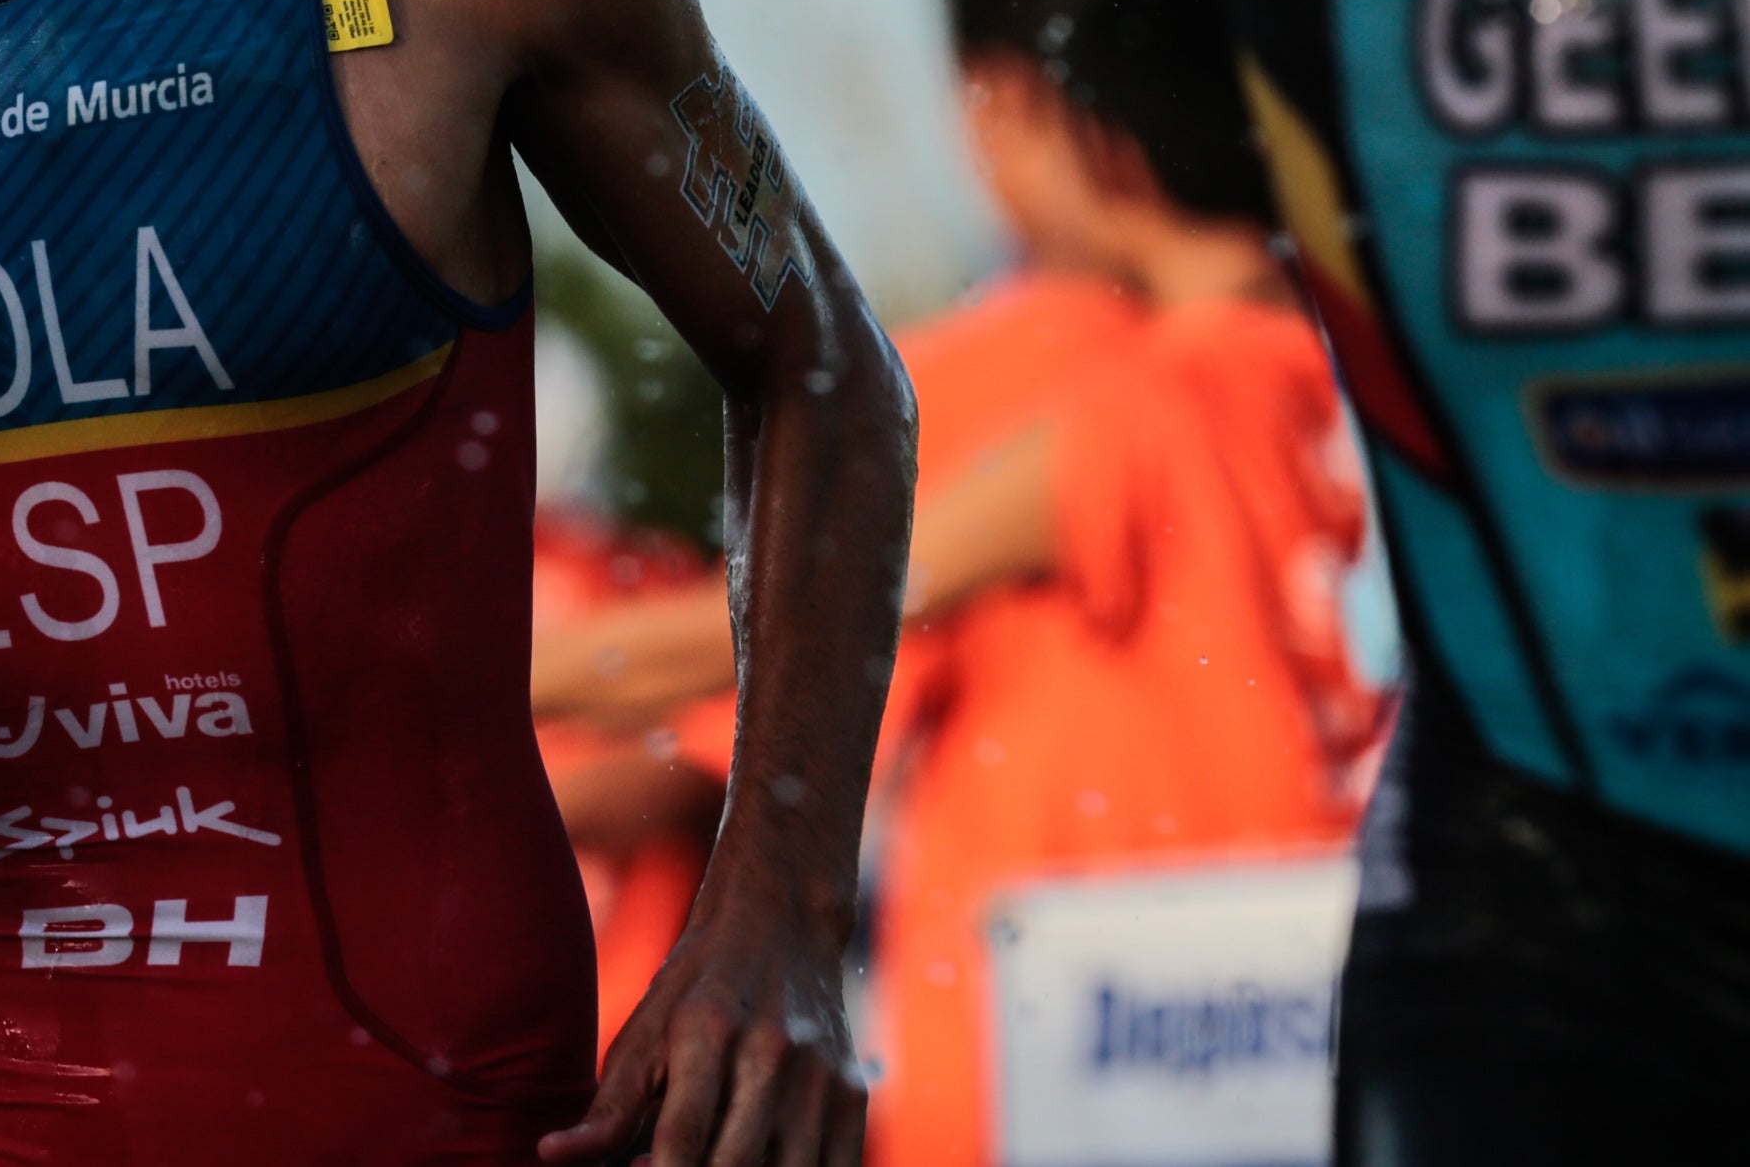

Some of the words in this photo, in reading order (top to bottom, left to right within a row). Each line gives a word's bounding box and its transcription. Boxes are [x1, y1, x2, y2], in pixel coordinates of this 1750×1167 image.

[1, 93, 50, 138] de
[65, 63, 215, 127] Murcia
[734, 135, 768, 228] LEADER
[54, 682, 254, 749] viva
[164, 671, 241, 691] hotels
[18, 895, 269, 969] BH
